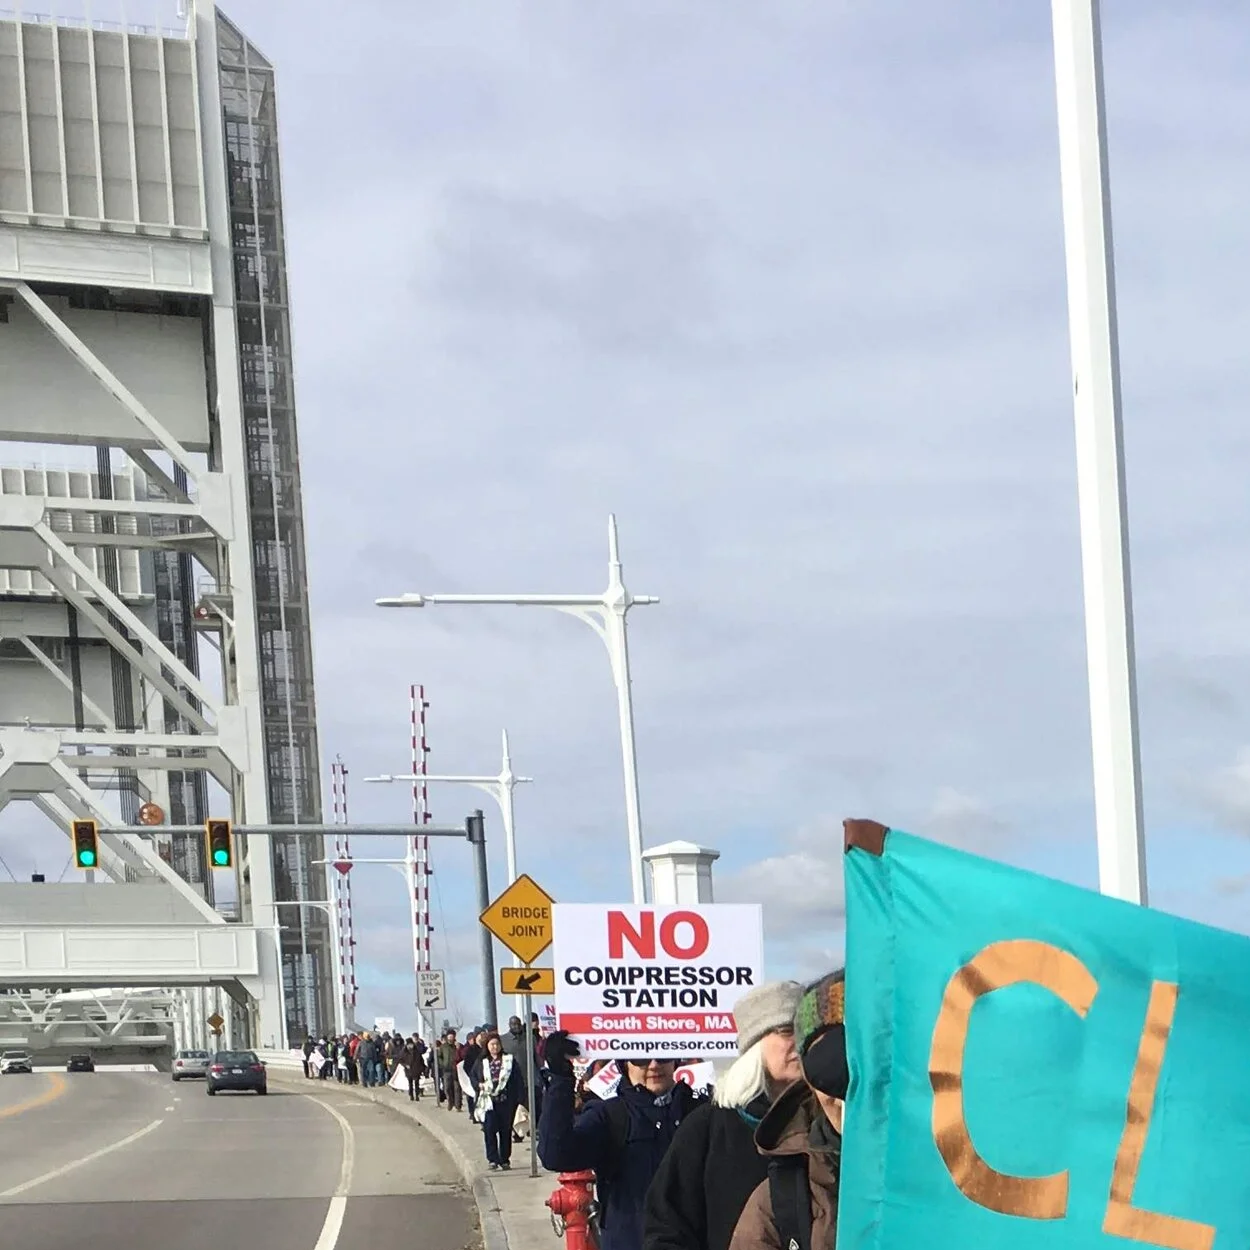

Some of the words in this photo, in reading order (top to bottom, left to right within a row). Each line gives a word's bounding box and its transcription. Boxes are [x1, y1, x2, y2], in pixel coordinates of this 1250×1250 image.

[502, 906, 549, 919] BRIDGE
[508, 925, 545, 937] JOINT
[607, 910, 710, 960] NO
[420, 973, 440, 981] STOP
[564, 966, 754, 986] COMPRESSOR
[602, 988, 718, 1008] STATION
[591, 1015, 642, 1030] South
[645, 1015, 701, 1032] Shore,
[704, 1015, 733, 1030] MA
[585, 1039, 739, 1053] NOCompressor.com
